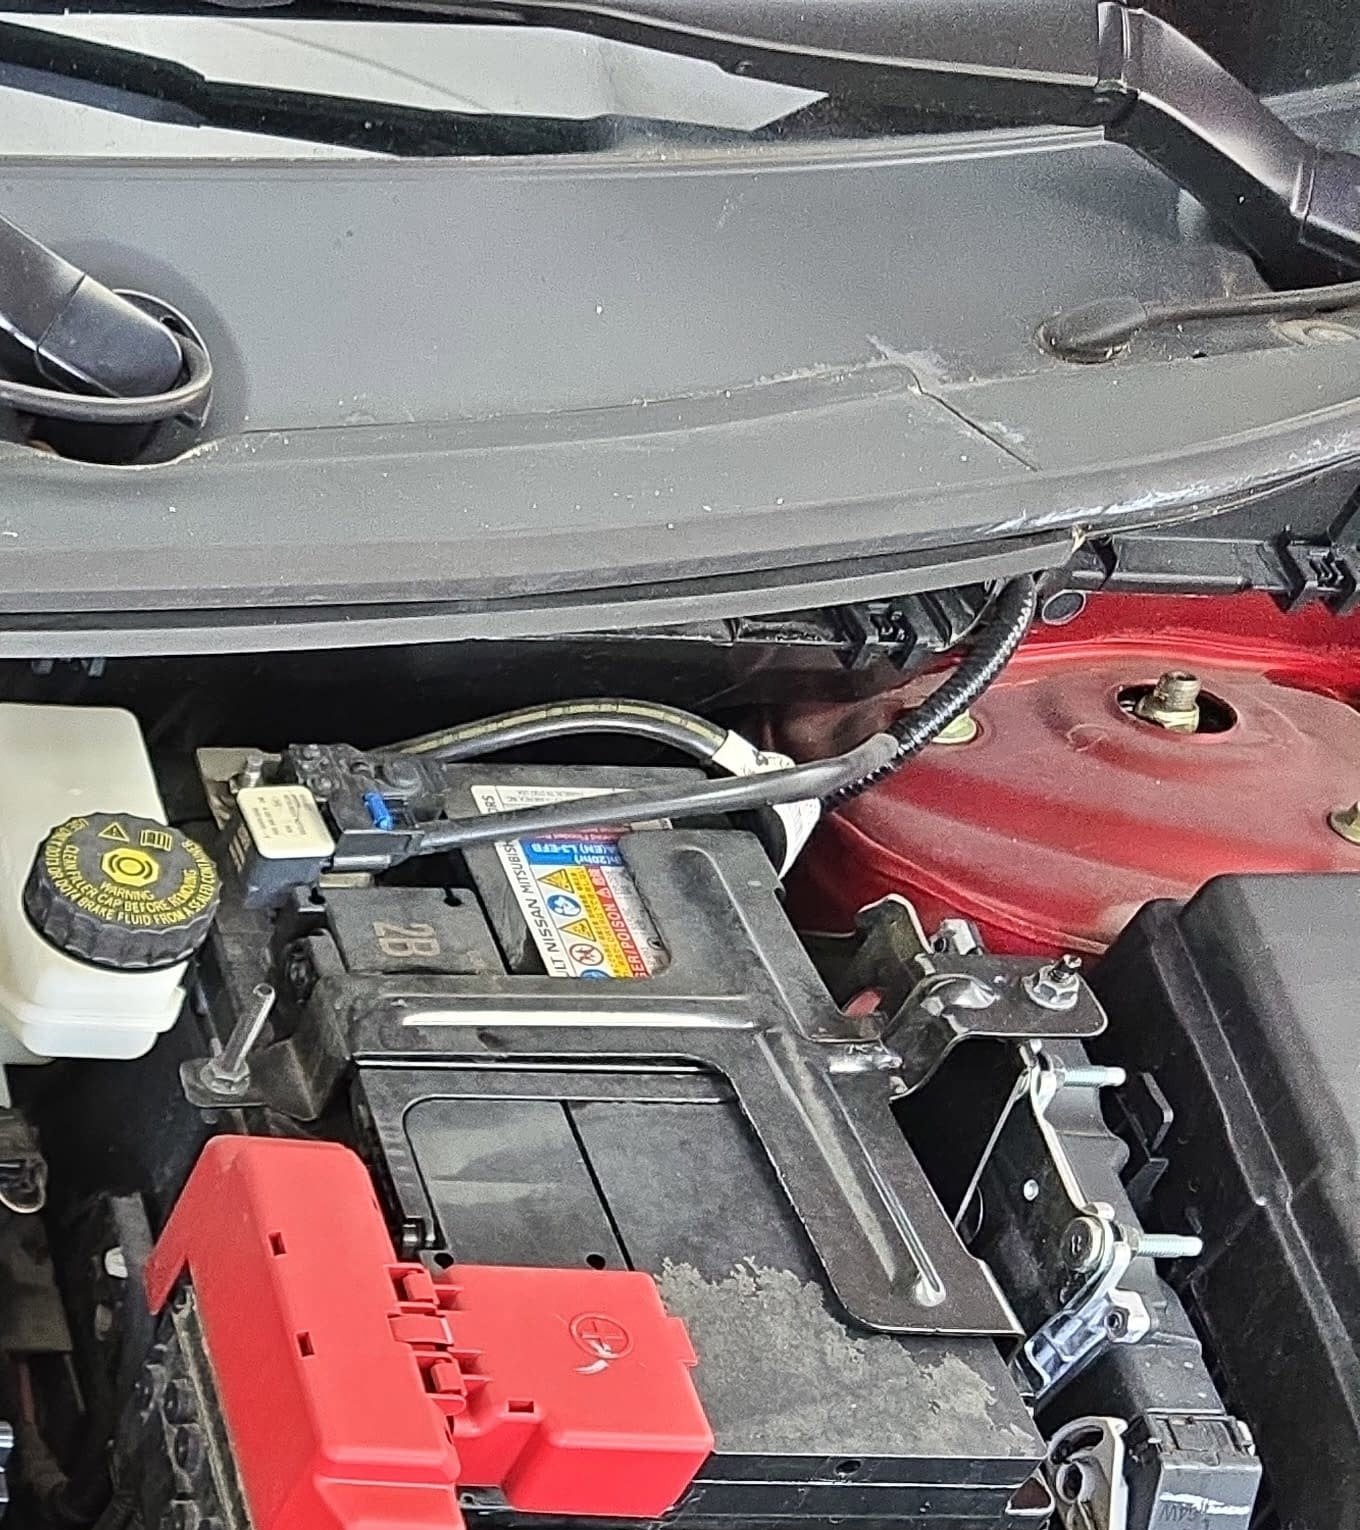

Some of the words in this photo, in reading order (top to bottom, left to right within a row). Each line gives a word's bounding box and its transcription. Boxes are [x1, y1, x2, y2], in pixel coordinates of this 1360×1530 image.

[63, 845, 80, 870] CLEAN
[97, 894, 120, 908] CAP
[124, 900, 171, 913] BEFORE
[99, 881, 155, 901] WARNING
[77, 897, 113, 920] BRAKE
[117, 913, 152, 925] FLUID
[152, 909, 186, 925] FROM
[526, 898, 559, 951] NISSAN
[373, 921, 440, 957] 2B
